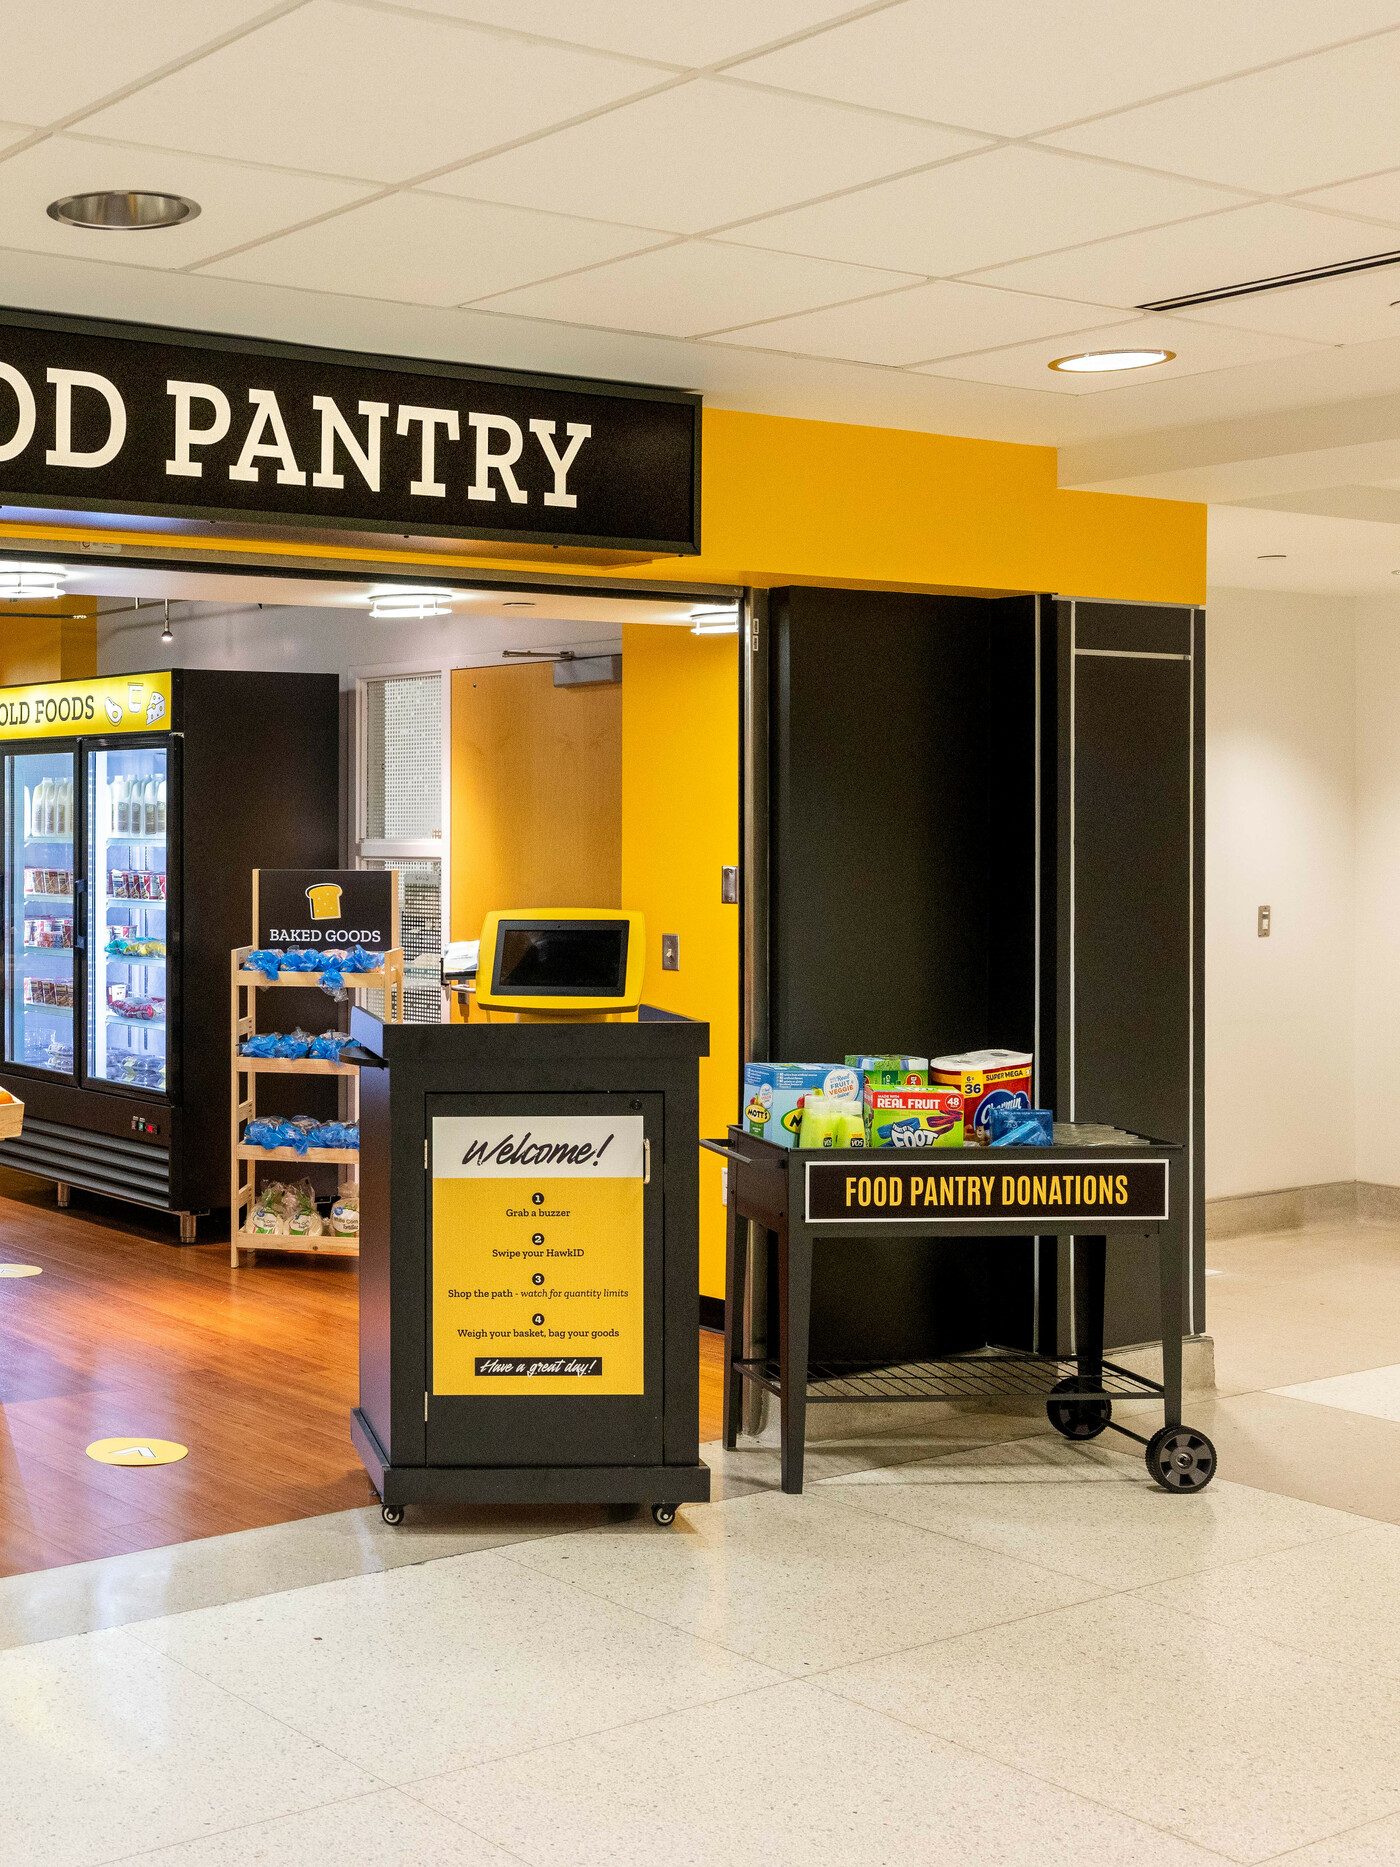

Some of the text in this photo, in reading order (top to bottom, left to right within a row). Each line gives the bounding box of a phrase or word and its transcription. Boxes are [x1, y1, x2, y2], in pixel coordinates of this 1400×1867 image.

[164, 379, 592, 508] PANTRY
[35, 695, 95, 724] FOODS
[269, 929, 381, 943] BAKED GOODS
[985, 1070, 1023, 1081] SUPER MEGA
[828, 1084, 854, 1096] VEGGIE
[830, 1080, 850, 1089] FRUIT
[964, 1083, 981, 1094] 36
[877, 1098, 941, 1110] REAL FRUIT
[947, 1097, 960, 1106] 48
[747, 1108, 768, 1120] MOTT'S
[891, 1129, 939, 1147] FOOT
[461, 1132, 614, 1167] Welcome!
[845, 1175, 1129, 1207] FOOD PANTRY DONATIONS
[505, 1208, 571, 1218] Grab a buzzer
[492, 1248, 585, 1260] Swipe your HawkID
[448, 1289, 471, 1300] Shop
[473, 1289, 489, 1298] the
[491, 1289, 513, 1300] path
[520, 1288, 548, 1298] watch
[547, 1288, 563, 1300] for
[563, 1288, 602, 1300] quantity
[603, 1288, 629, 1298] limits
[457, 1328, 620, 1340] Weigh your basket, bag your goods
[479, 1358, 596, 1378] Have a great day!
